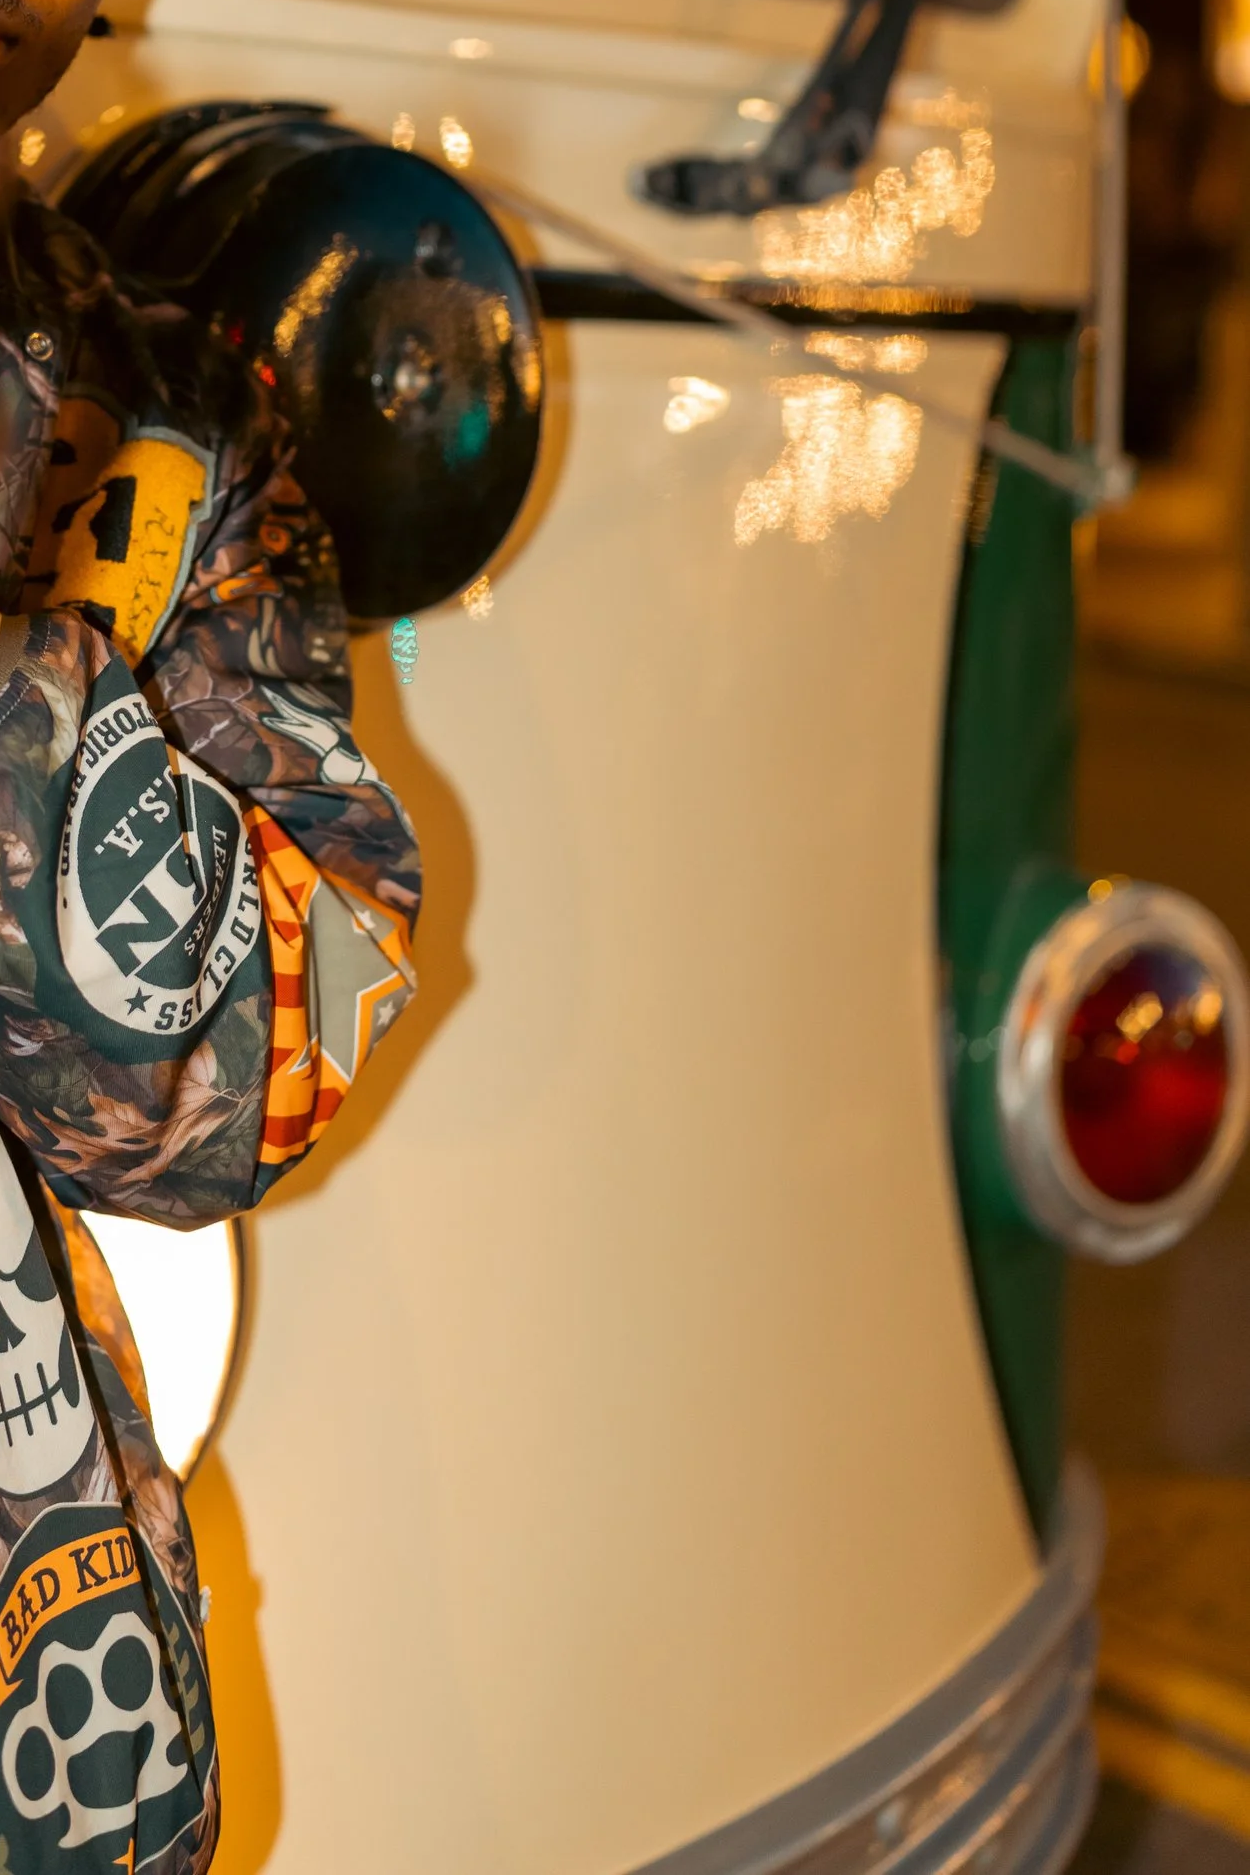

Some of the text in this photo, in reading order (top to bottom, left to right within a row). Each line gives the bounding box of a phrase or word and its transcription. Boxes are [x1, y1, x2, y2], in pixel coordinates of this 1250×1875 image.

[78, 700, 159, 768] TORIC
[184, 824, 227, 957] LEADERS
[154, 944, 238, 1032] CLSS
[1, 1567, 61, 1659] BAD
